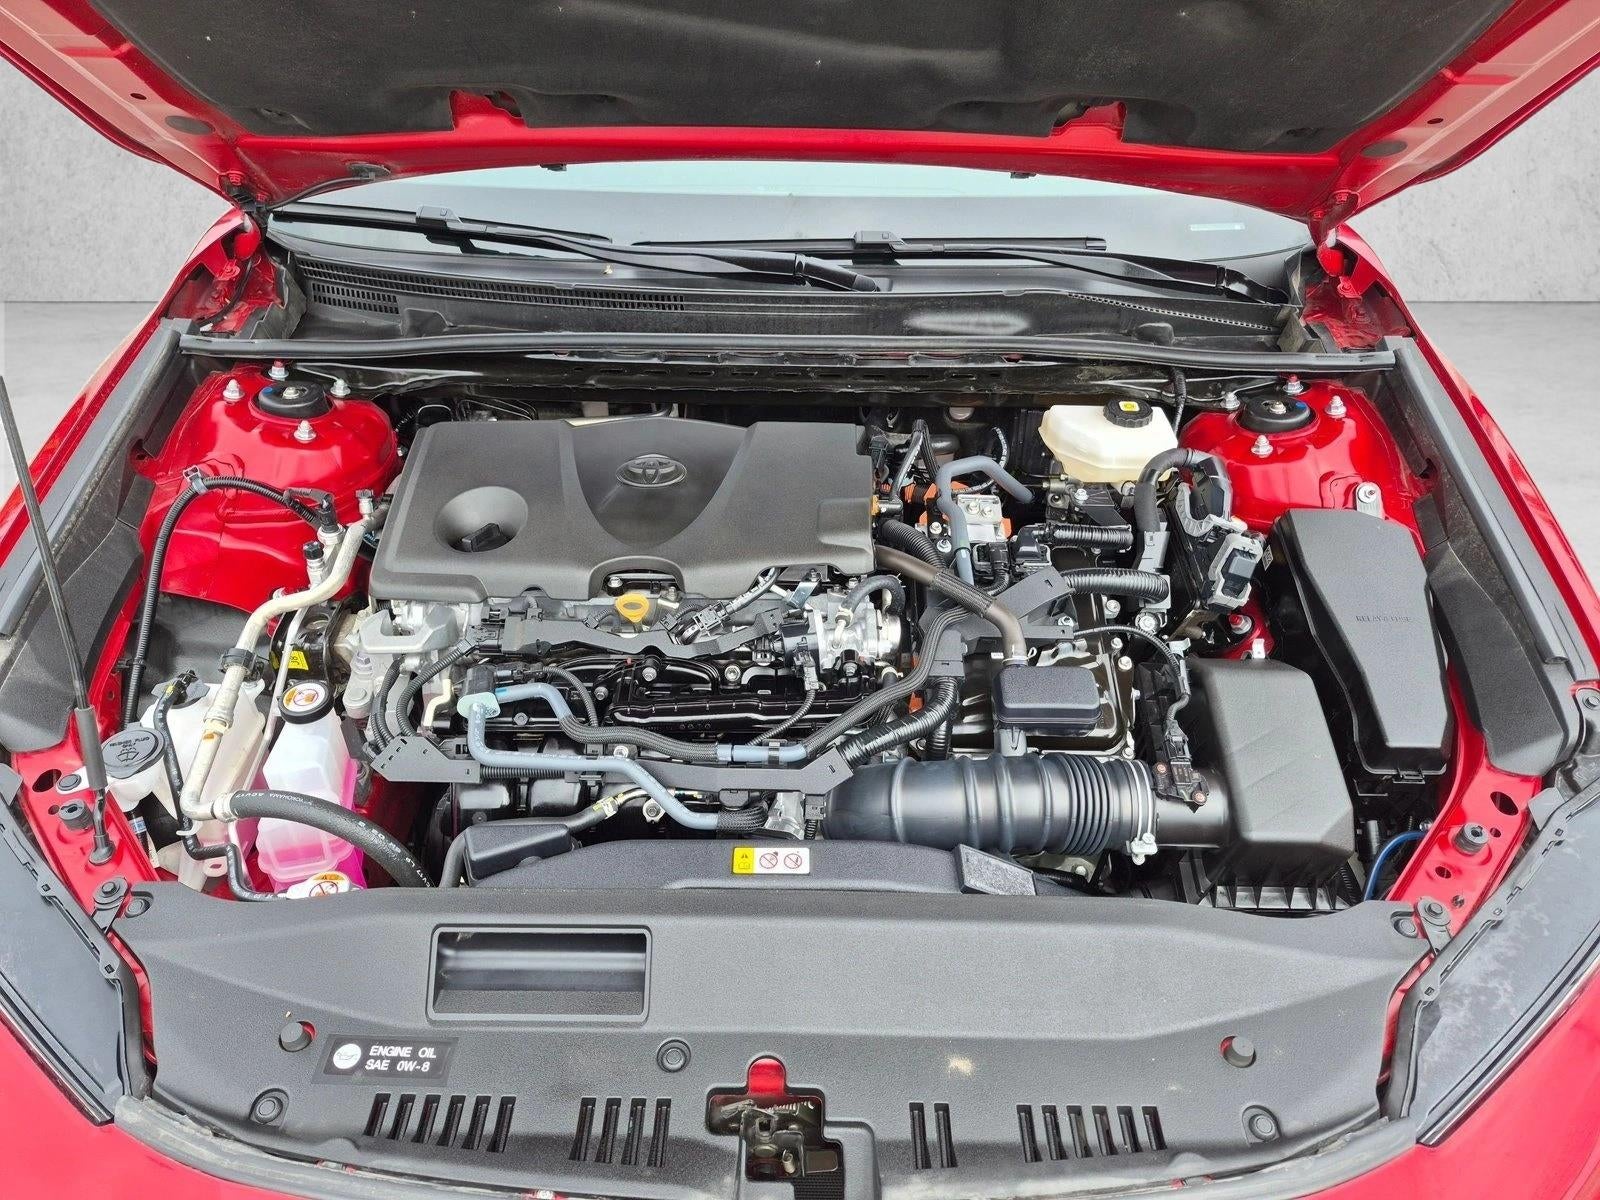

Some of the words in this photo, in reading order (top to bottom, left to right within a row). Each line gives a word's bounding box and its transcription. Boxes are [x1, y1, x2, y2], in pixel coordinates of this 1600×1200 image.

[269, 793, 304, 803] YOKOHAMA
[369, 1045, 413, 1058] ENGINE
[418, 1047, 437, 1059] OIL
[365, 1059, 390, 1071] SAE
[396, 1060, 431, 1072] 0W-8
